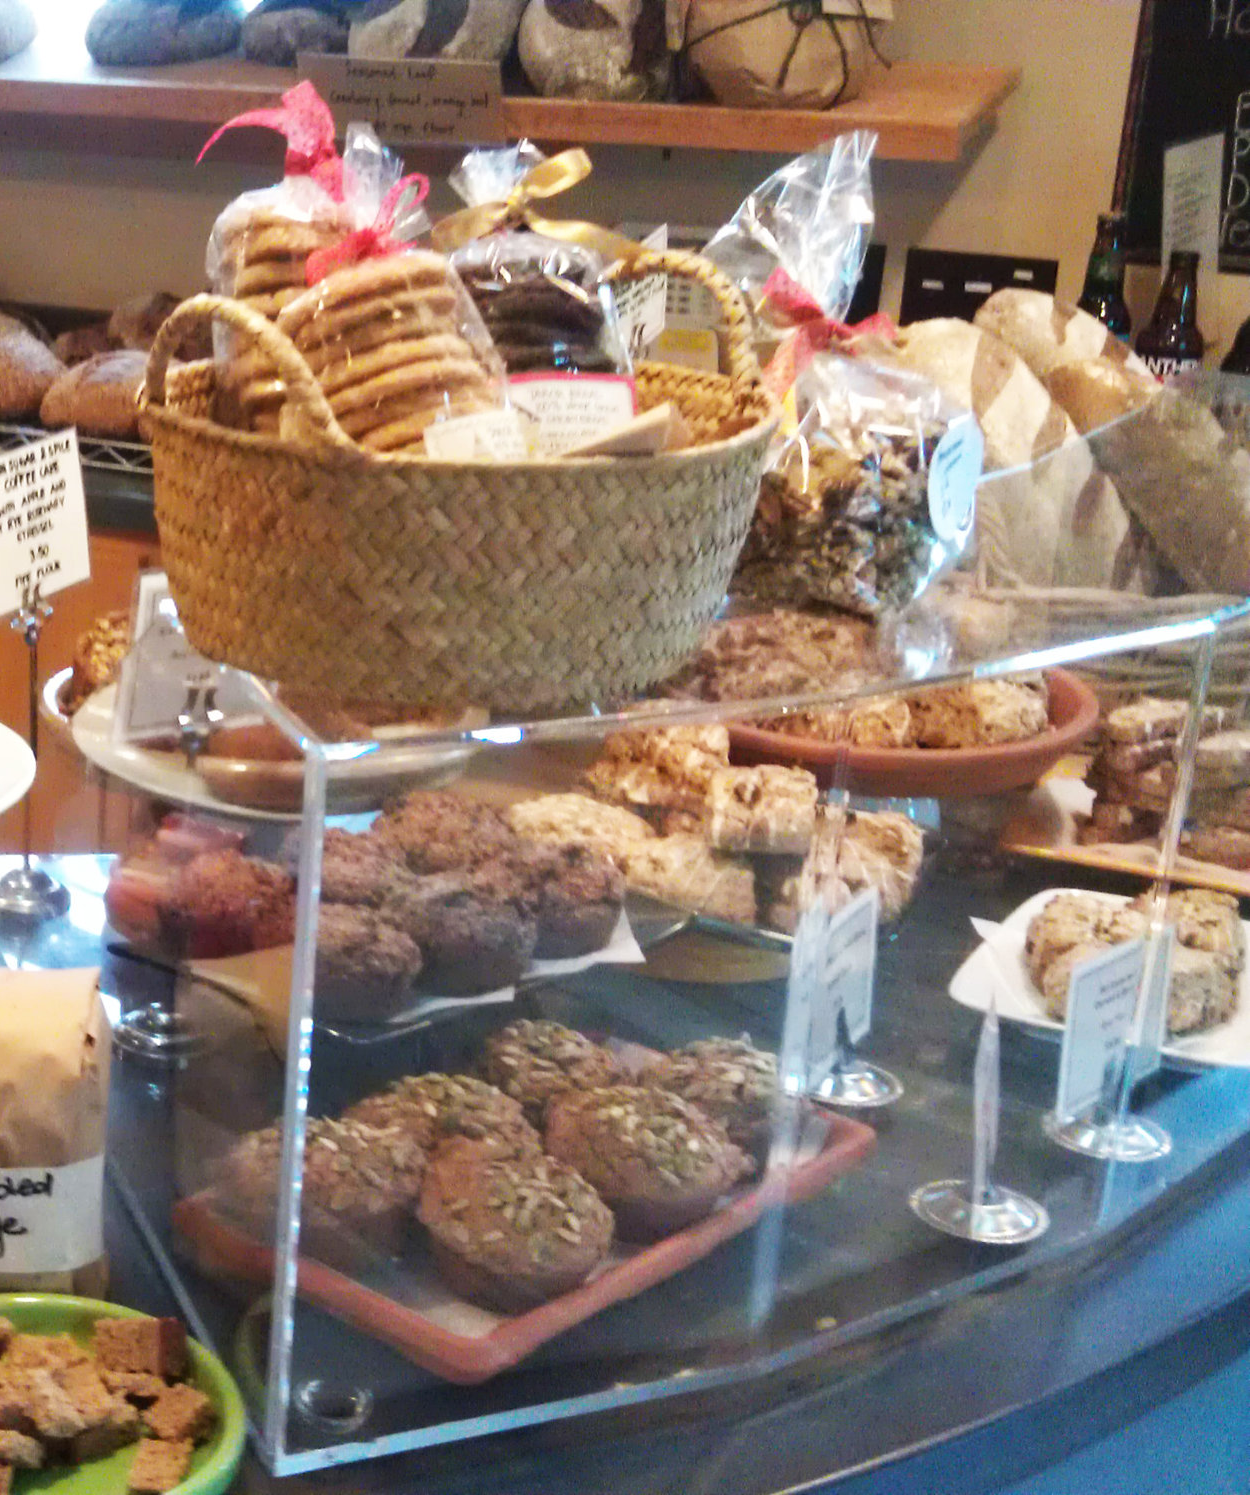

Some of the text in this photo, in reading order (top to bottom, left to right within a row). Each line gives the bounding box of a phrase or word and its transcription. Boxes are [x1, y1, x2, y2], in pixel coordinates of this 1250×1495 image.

[4, 470, 37, 493] COFFEE
[21, 488, 46, 508] APPLE
[50, 478, 67, 495] AND
